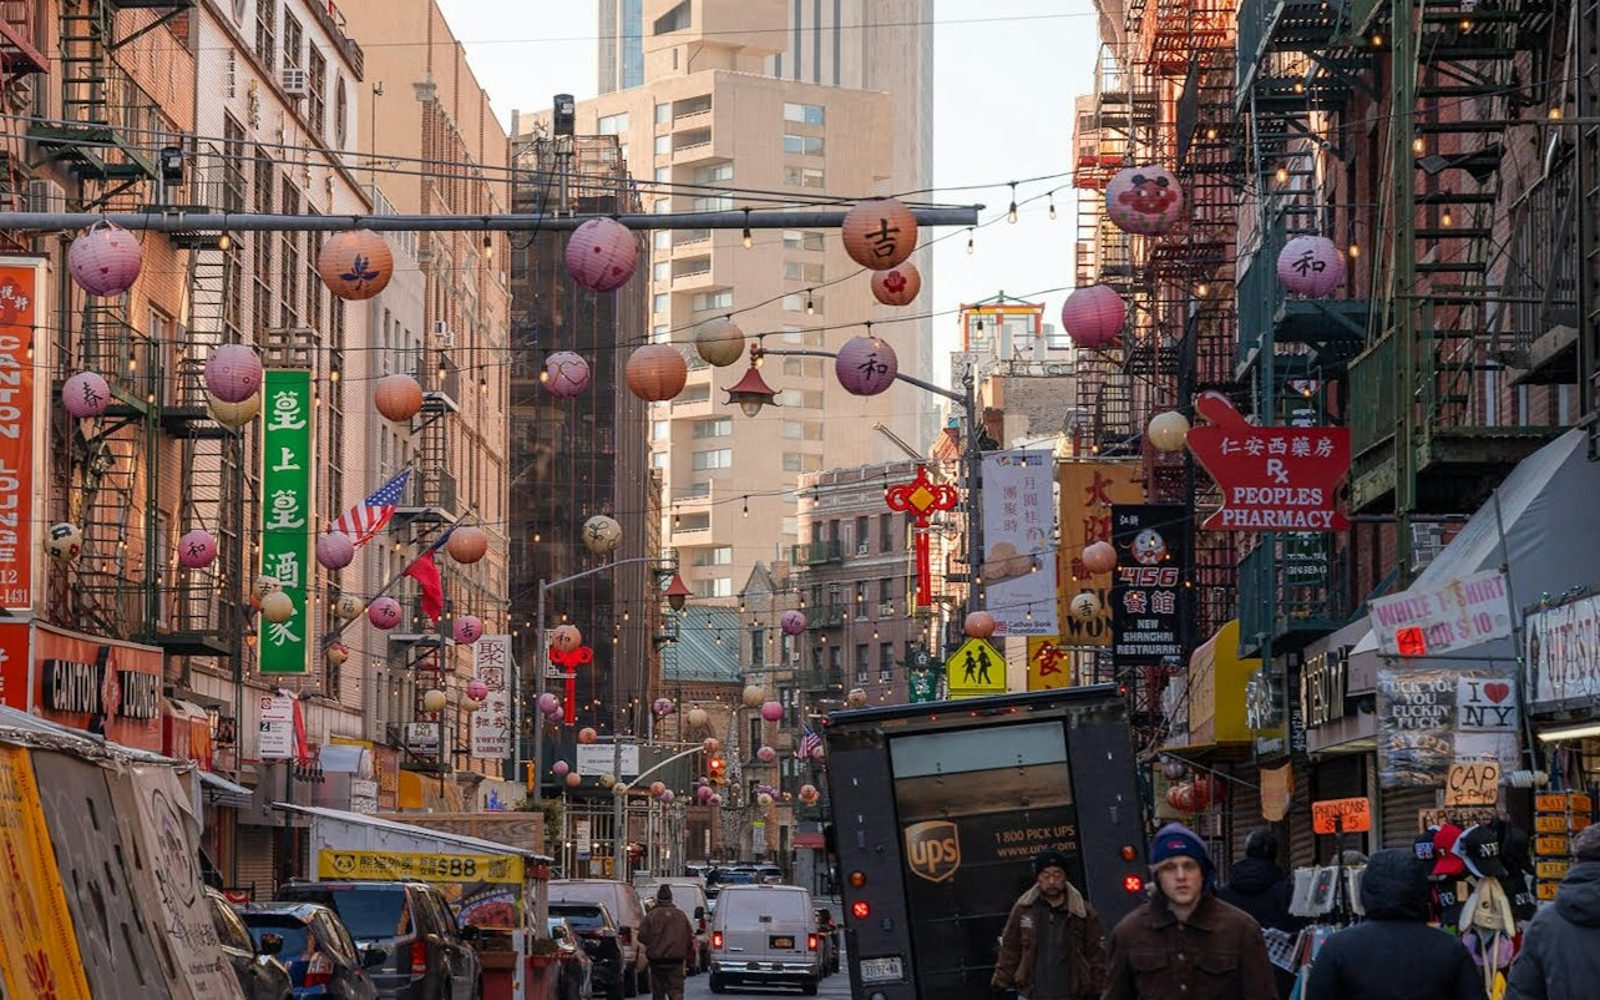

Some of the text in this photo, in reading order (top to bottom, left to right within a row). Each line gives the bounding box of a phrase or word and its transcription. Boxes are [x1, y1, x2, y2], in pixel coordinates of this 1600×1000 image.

[864, 218, 901, 260] 吉
[1292, 249, 1326, 277] 和
[857, 353, 888, 381] 和
[1220, 436, 1335, 459] 仁安西藥房
[1233, 487, 1323, 506] PEOPLES
[1222, 510, 1335, 528] PHARMACY
[1119, 567, 1179, 587] 456
[1377, 594, 1432, 627] WHITE
[1137, 619, 1159, 629] NEW
[1123, 632, 1173, 642] SHANGHAI
[1116, 645, 1182, 655] RESTAURANT
[53, 659, 98, 714] CANTON
[1467, 682, 1482, 702] I
[1403, 693, 1437, 705] YOU
[1398, 717, 1441, 728] FUCK
[1462, 705, 1516, 727] NY
[1450, 766, 1496, 791] CAP
[1002, 830, 1024, 842] 800
[1026, 828, 1052, 840] PICK
[1053, 825, 1076, 838] UPS
[911, 838, 958, 873] ups
